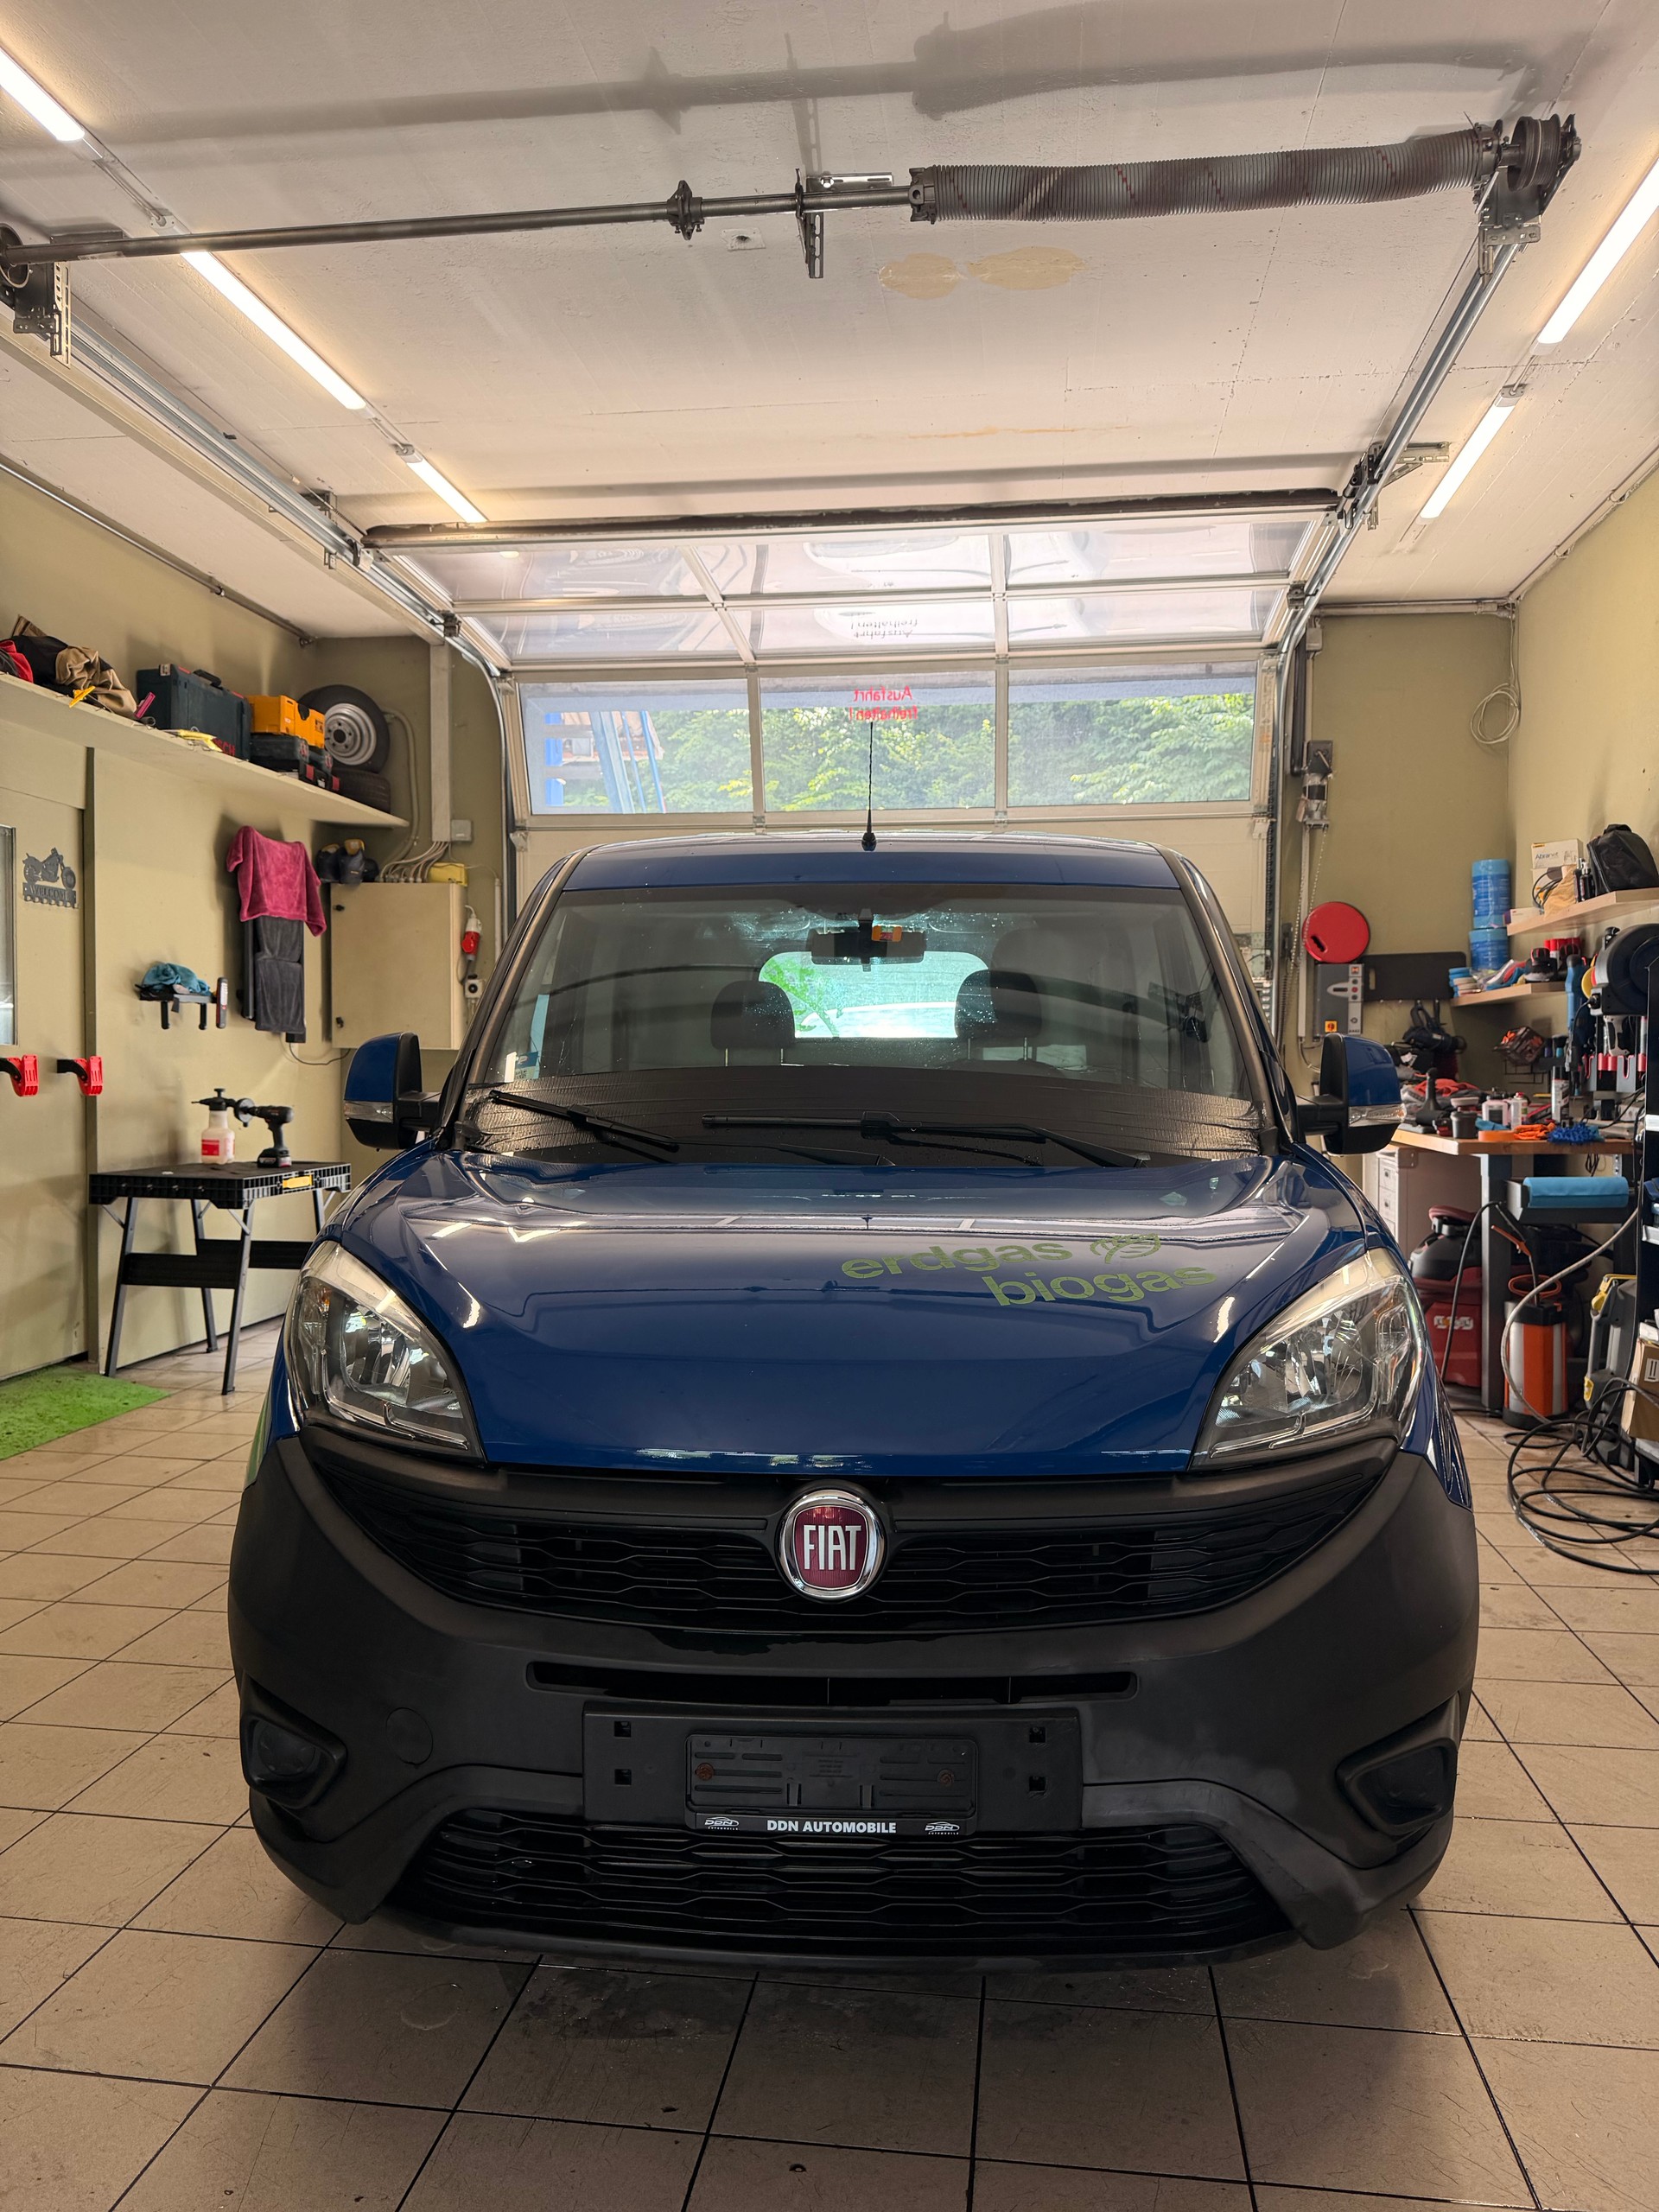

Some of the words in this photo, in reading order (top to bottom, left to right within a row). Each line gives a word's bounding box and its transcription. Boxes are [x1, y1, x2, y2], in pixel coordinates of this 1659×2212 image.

[29, 885, 73, 900] WELCOME
[841, 1243, 1073, 1280] erdgas
[982, 1266, 1217, 1306] biogas
[803, 1524, 862, 1571] FIAT
[766, 1820, 799, 1832] DDN
[803, 1821, 897, 1834] AUTOMOBILE
